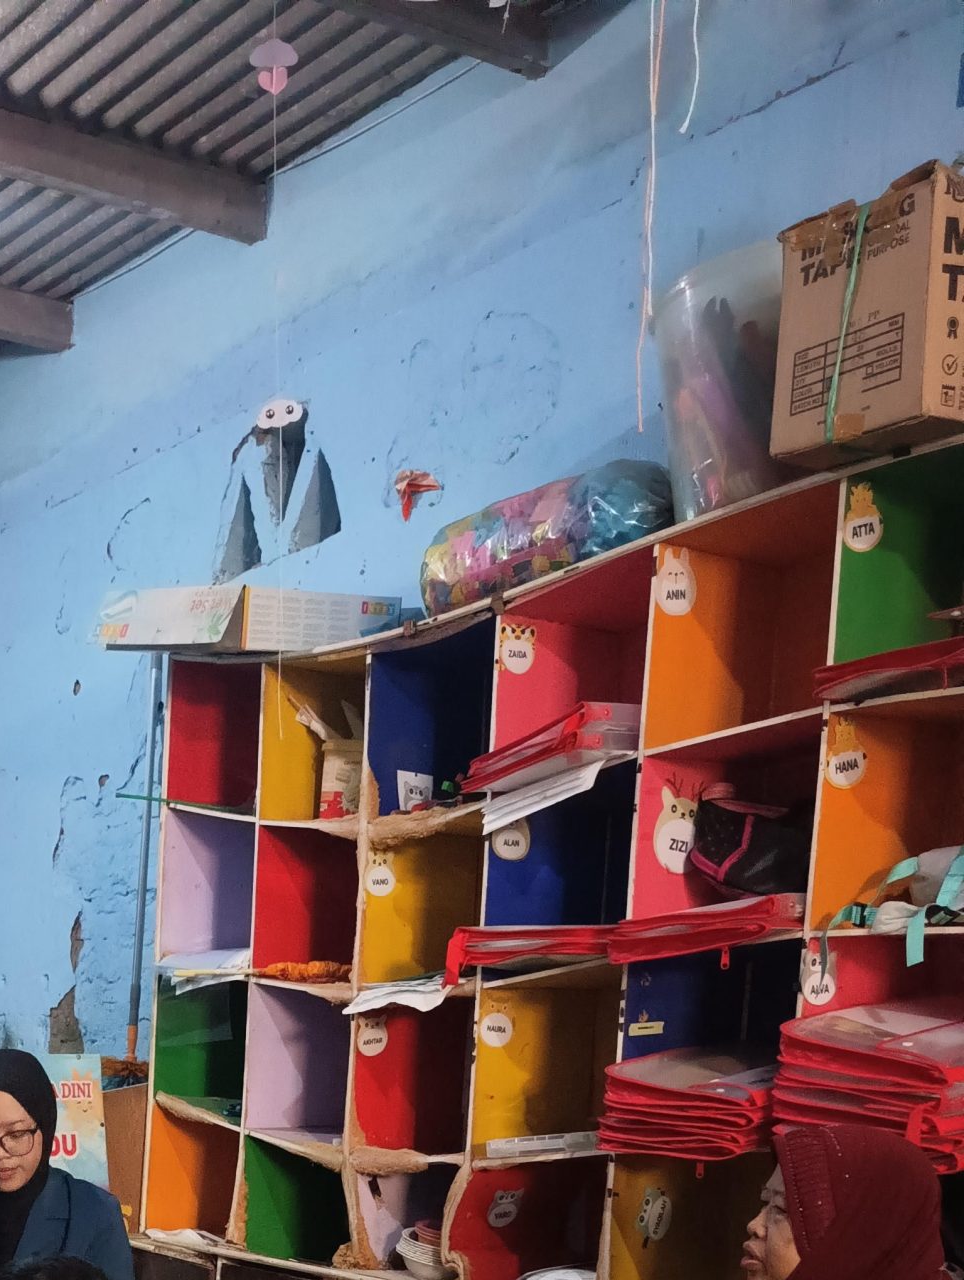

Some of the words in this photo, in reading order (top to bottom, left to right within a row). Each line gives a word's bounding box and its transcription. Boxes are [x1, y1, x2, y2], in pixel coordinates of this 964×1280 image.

[852, 522, 875, 539] ATTA
[666, 589, 686, 600] ANIN
[508, 649, 527, 659] ZAIDA
[835, 758, 859, 775] HANA
[503, 839, 520, 847] ALAN
[669, 838, 689, 853] ZIZI
[61, 1083, 92, 1098] DINI
